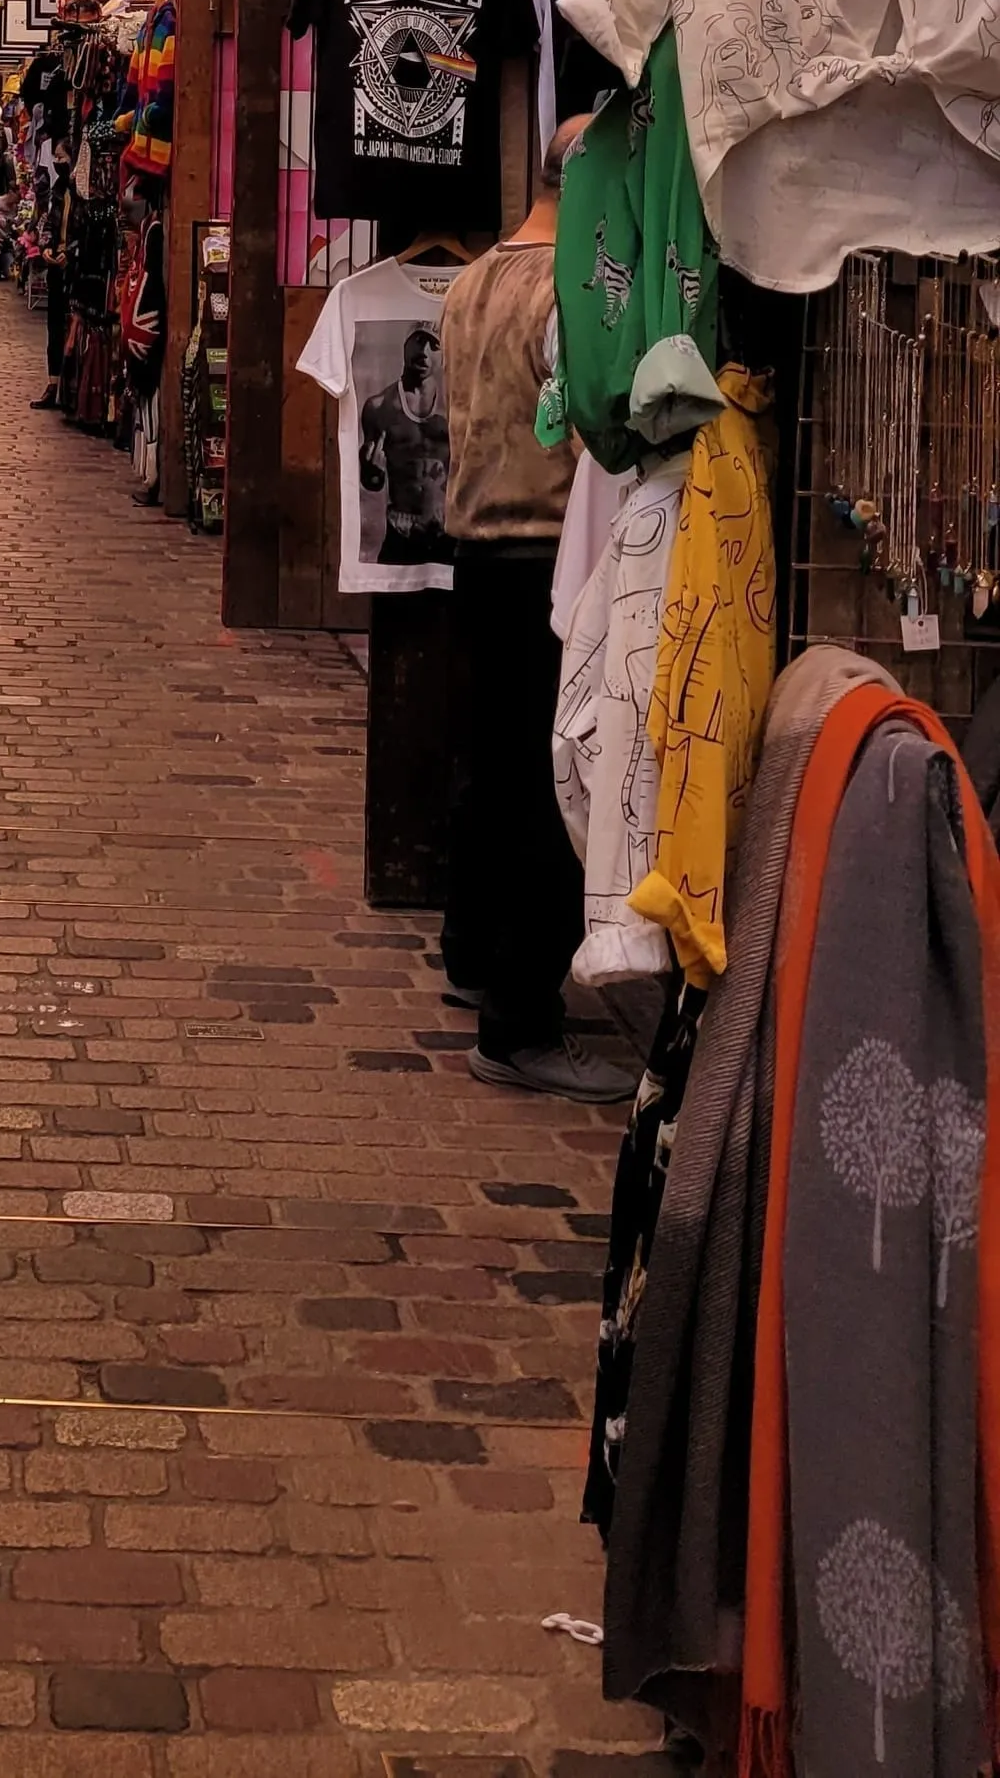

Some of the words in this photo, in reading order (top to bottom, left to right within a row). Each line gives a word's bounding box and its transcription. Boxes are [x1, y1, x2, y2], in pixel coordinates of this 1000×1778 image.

[354, 140, 364, 156] UK
[367, 140, 390, 158] JAPAN
[409, 145, 435, 164] AMERICA
[438, 148, 463, 166] EUROPE
